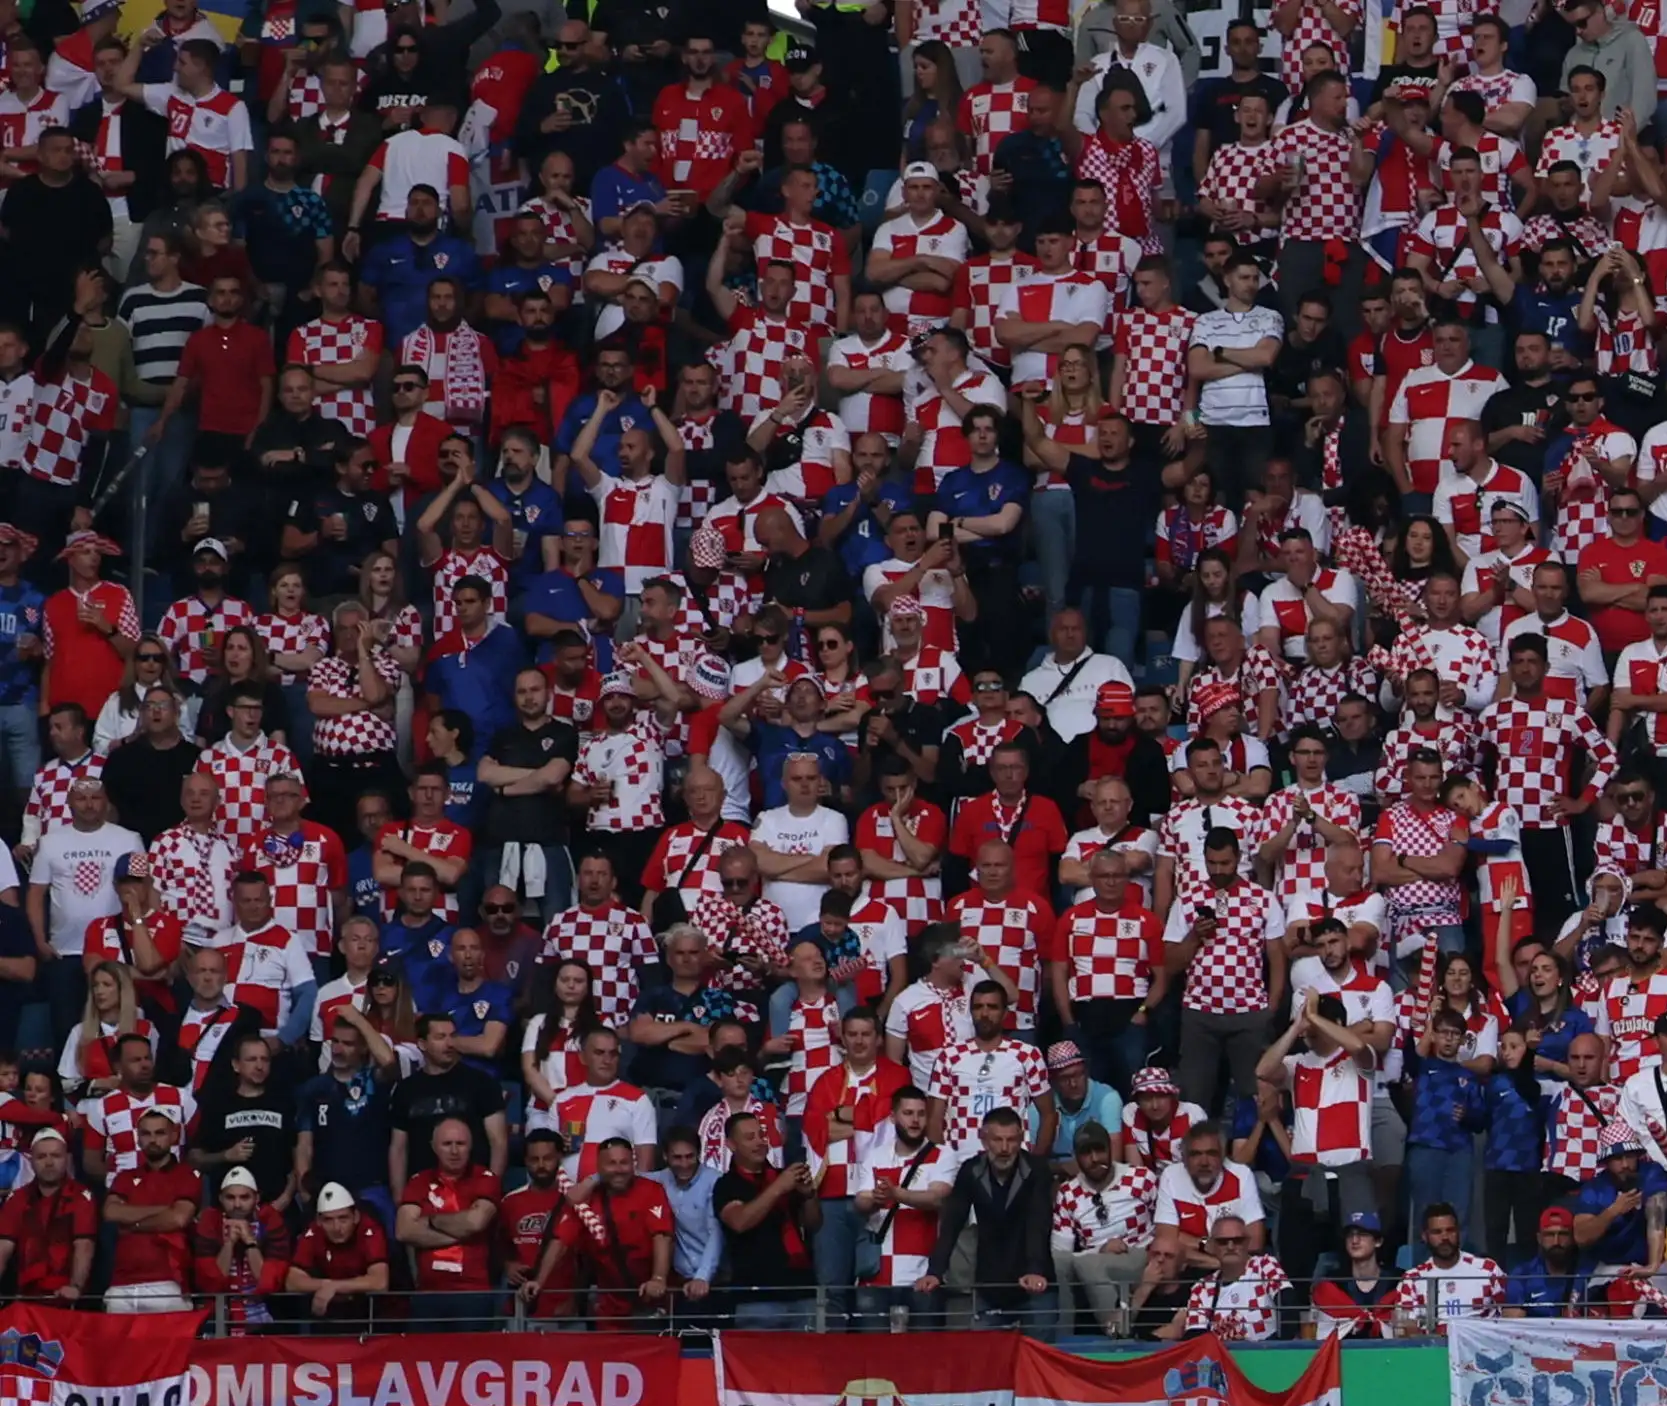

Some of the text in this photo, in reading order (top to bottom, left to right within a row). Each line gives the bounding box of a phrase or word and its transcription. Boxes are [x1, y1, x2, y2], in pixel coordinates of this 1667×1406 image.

[1636, 7, 1656, 27] 10
[1615, 334, 1630, 353] 10
[60, 393, 73, 410] 7
[1520, 730, 1534, 754] 2
[777, 830, 819, 841] CROATIA
[63, 850, 112, 860] CROATIA
[973, 1094, 994, 1114] 20
[318, 1104, 328, 1126] 8
